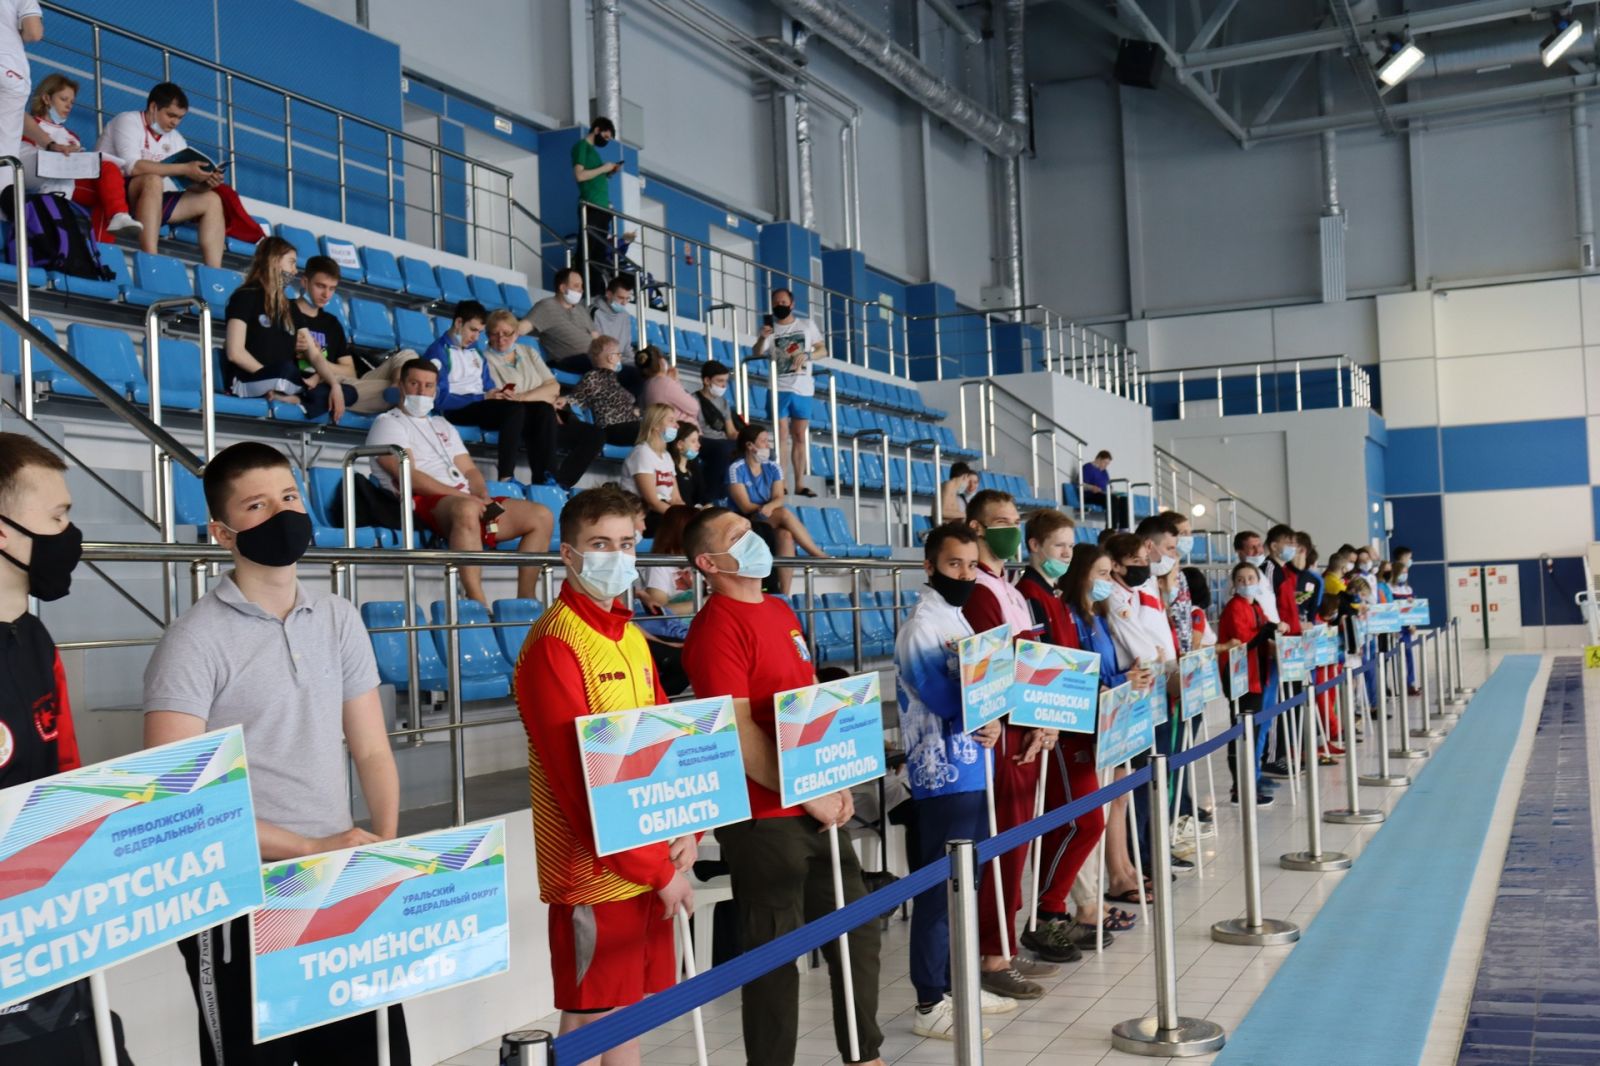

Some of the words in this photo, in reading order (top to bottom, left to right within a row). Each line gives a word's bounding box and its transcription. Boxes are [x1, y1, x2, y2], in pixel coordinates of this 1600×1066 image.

[1023, 689, 1090, 711] САРАТОВСКАЯ
[1034, 707, 1078, 725] ОБЛАСТЬ
[815, 739, 857, 767] ГОРОД
[628, 770, 720, 809] ТУЛЬСКАЯ
[793, 754, 879, 796] СЕВАСТОПОЛЬ
[111, 803, 204, 843] ПРИВОЛЖСКИЙ
[113, 820, 206, 857] ФЕДЕРАЛЬНЫЙ
[206, 806, 244, 829] ОКРУГ
[639, 799, 720, 836] ОБЛАСТЬ
[402, 884, 456, 904] УРАЛЬСКИЙ
[402, 892, 470, 917] ФЕДЕРАЛЬНЫЙ
[470, 887, 499, 902] ОКРУГ
[0, 881, 230, 989] ЕСПУБЛИКА
[299, 914, 479, 981] ТЮМЕНСКАЯ
[201, 958, 213, 986] EA7
[328, 952, 457, 1008] ОБЛАСТЬ
